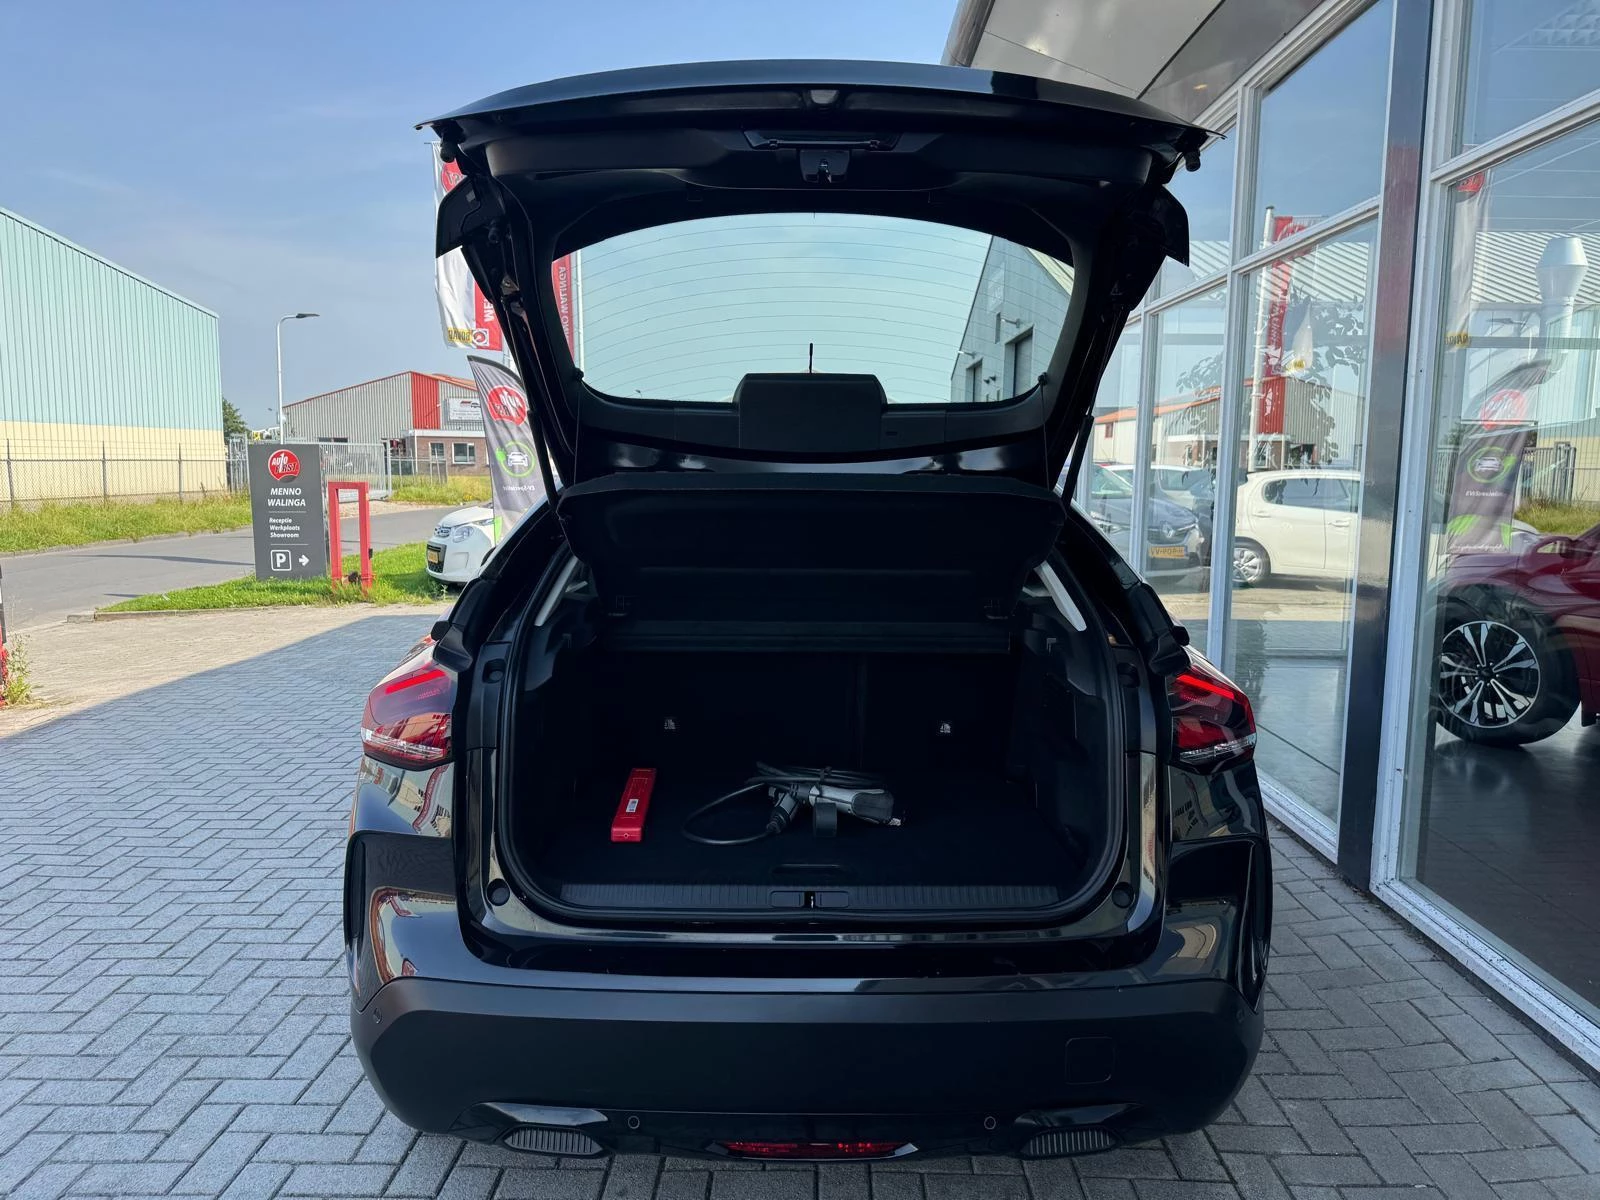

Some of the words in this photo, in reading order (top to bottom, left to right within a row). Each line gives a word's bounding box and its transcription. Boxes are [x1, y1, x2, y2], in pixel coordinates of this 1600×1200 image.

[270, 487, 302, 496] MENNO
[267, 498, 306, 507] WALINGA
[275, 553, 286, 568] P
